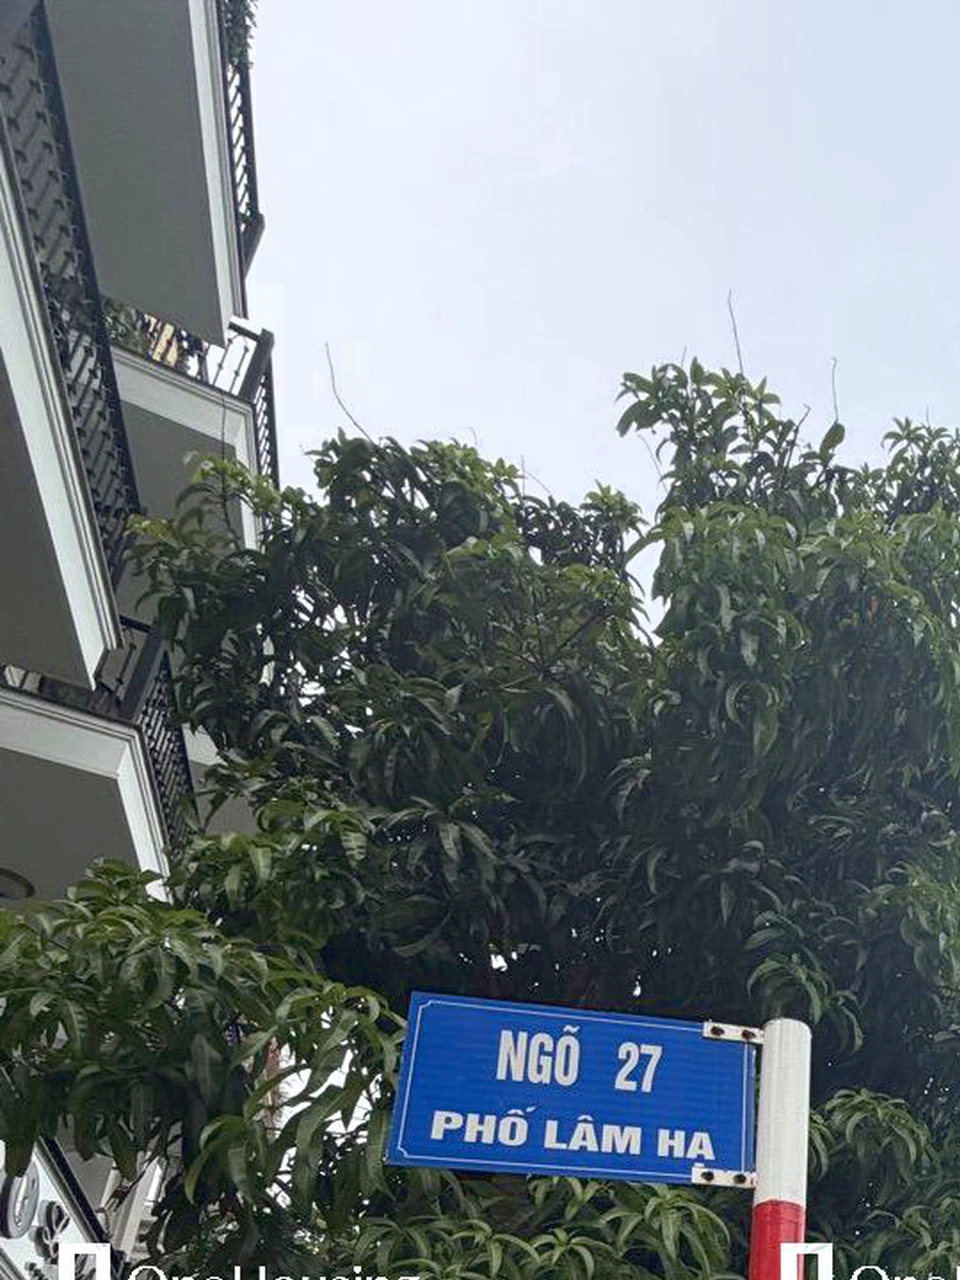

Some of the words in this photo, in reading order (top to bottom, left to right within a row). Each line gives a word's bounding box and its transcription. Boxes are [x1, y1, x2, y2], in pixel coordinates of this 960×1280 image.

[495, 1025, 580, 1087] NGÕ
[614, 1042, 663, 1093] 27
[429, 1106, 536, 1147] PHỐ
[543, 1114, 642, 1156] LÂM
